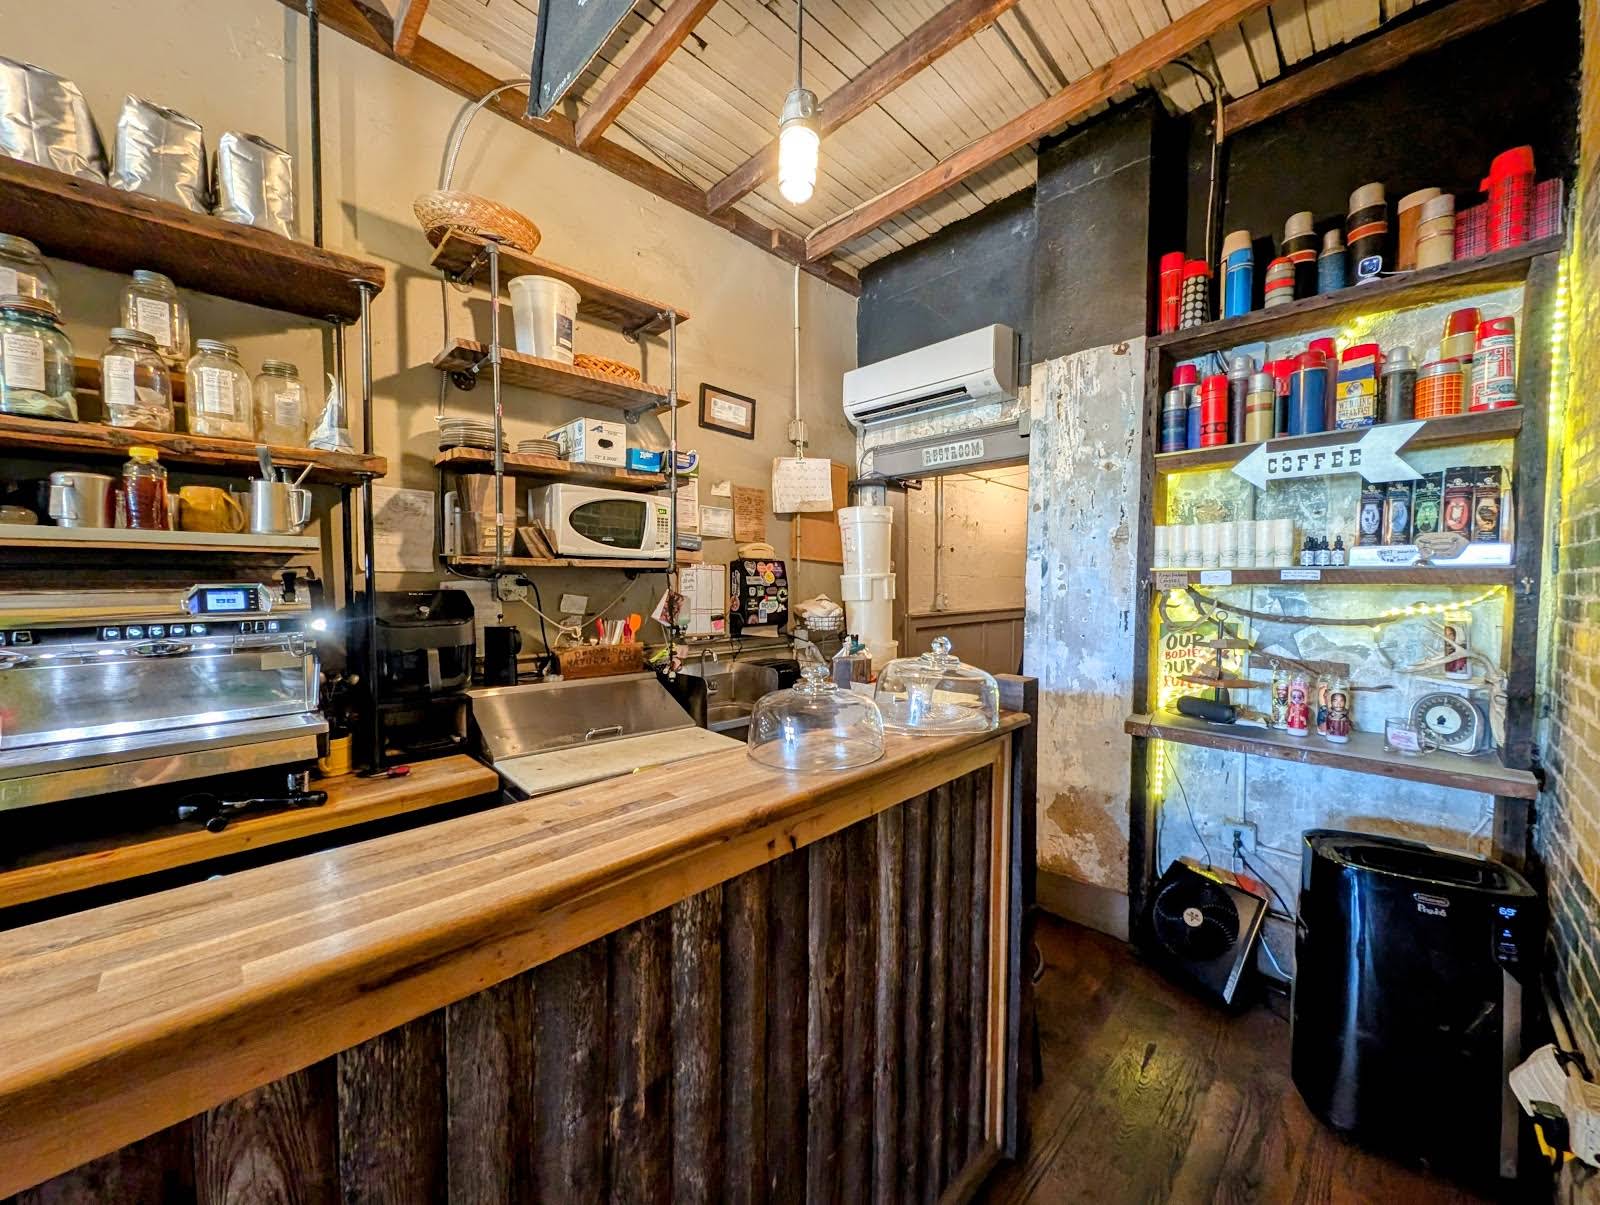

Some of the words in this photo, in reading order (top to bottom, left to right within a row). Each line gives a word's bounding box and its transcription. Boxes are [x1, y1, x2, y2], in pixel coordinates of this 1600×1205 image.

[925, 441, 981, 464] RESTROOM
[1267, 447, 1362, 474] COFFEE
[1166, 633, 1205, 650] OUR
[1165, 648, 1200, 660] BODIE
